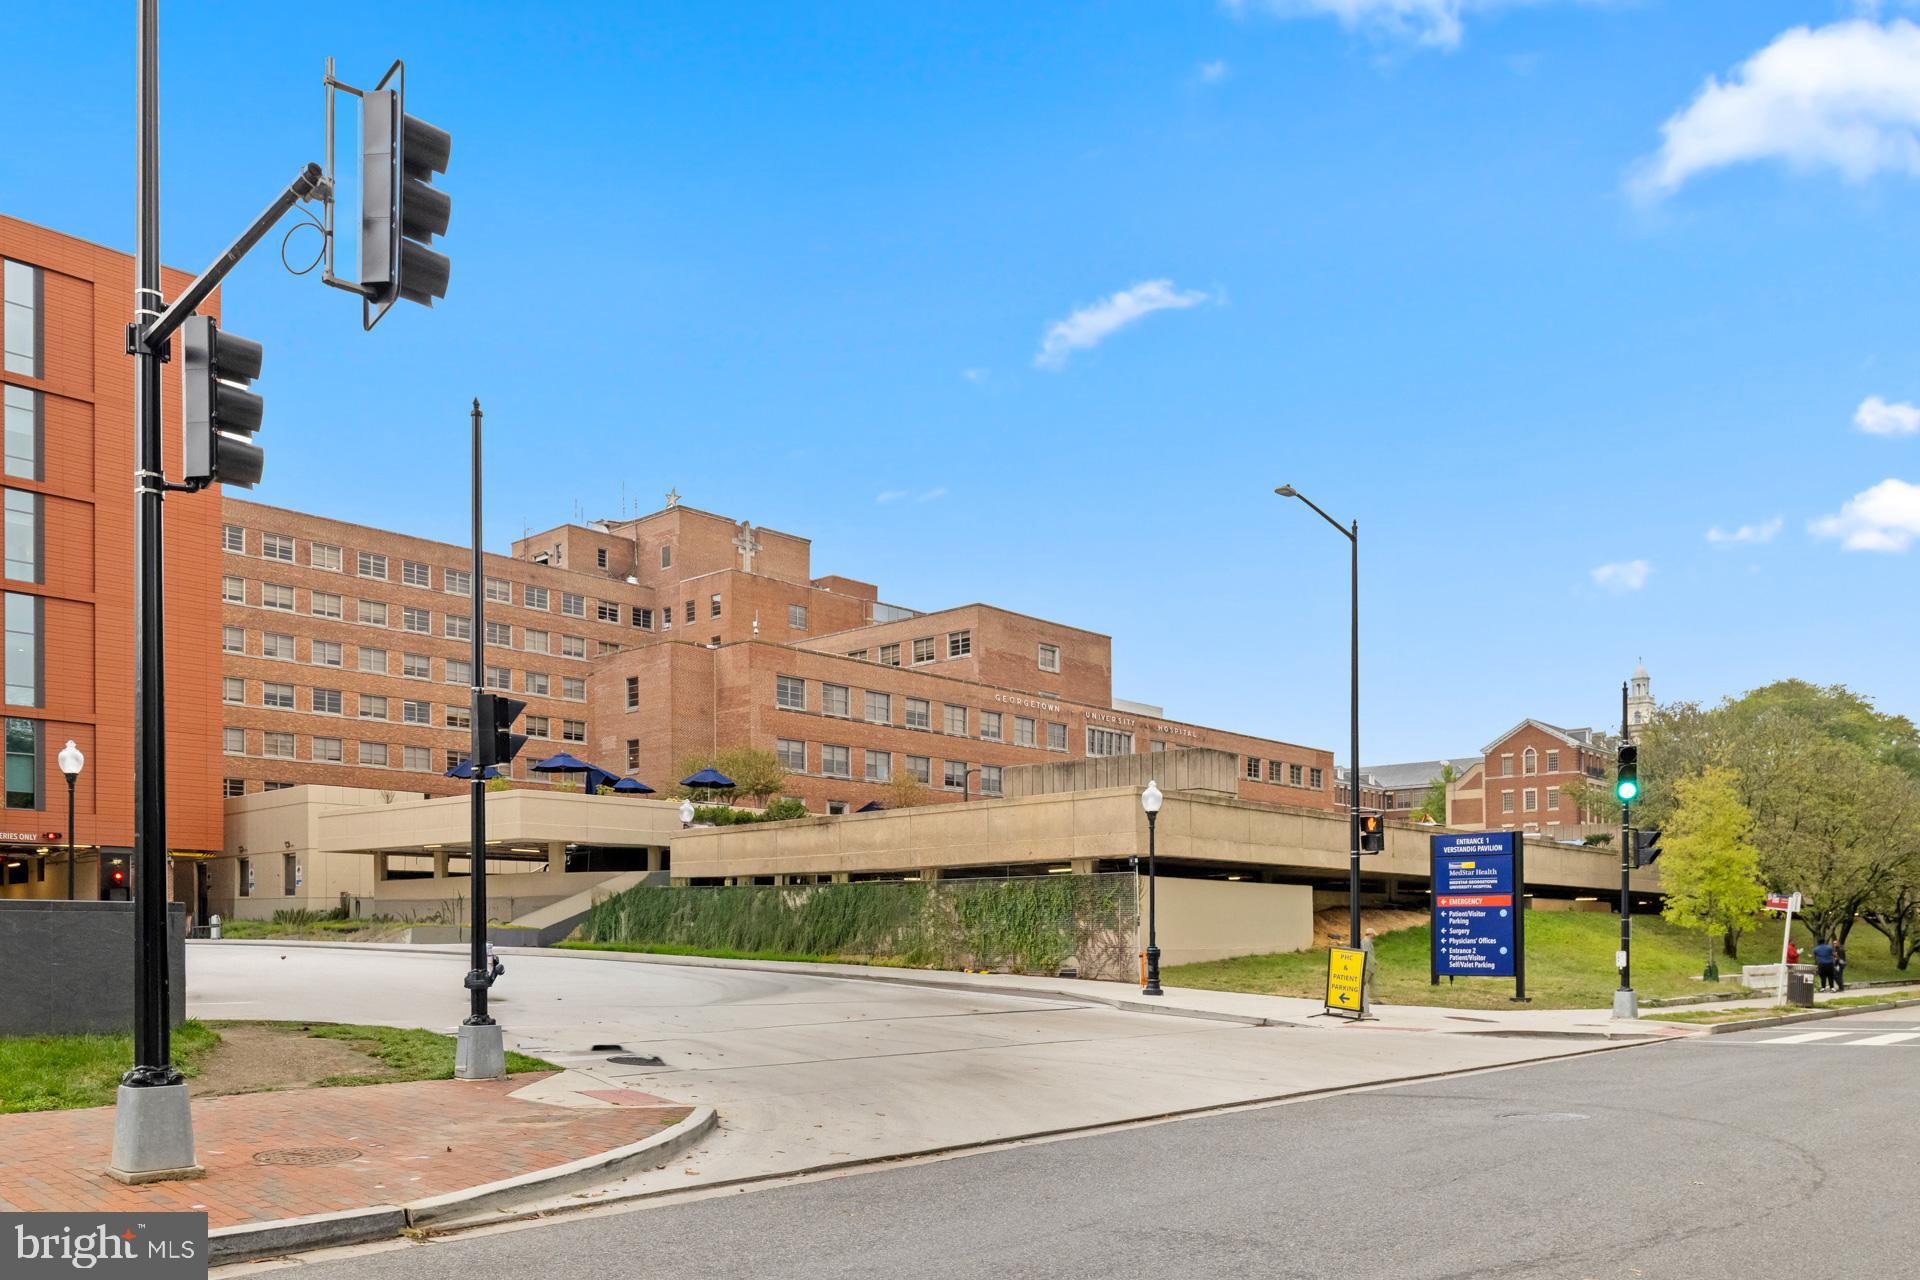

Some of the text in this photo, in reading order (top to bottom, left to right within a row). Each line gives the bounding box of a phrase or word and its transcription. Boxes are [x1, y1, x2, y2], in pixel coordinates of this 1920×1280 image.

[995, 694, 1197, 738] GEORGETOWN UNIVERSITY HOSPITAL
[1333, 974, 1358, 982] PATIENT
[1331, 984, 1358, 992] PARKING
